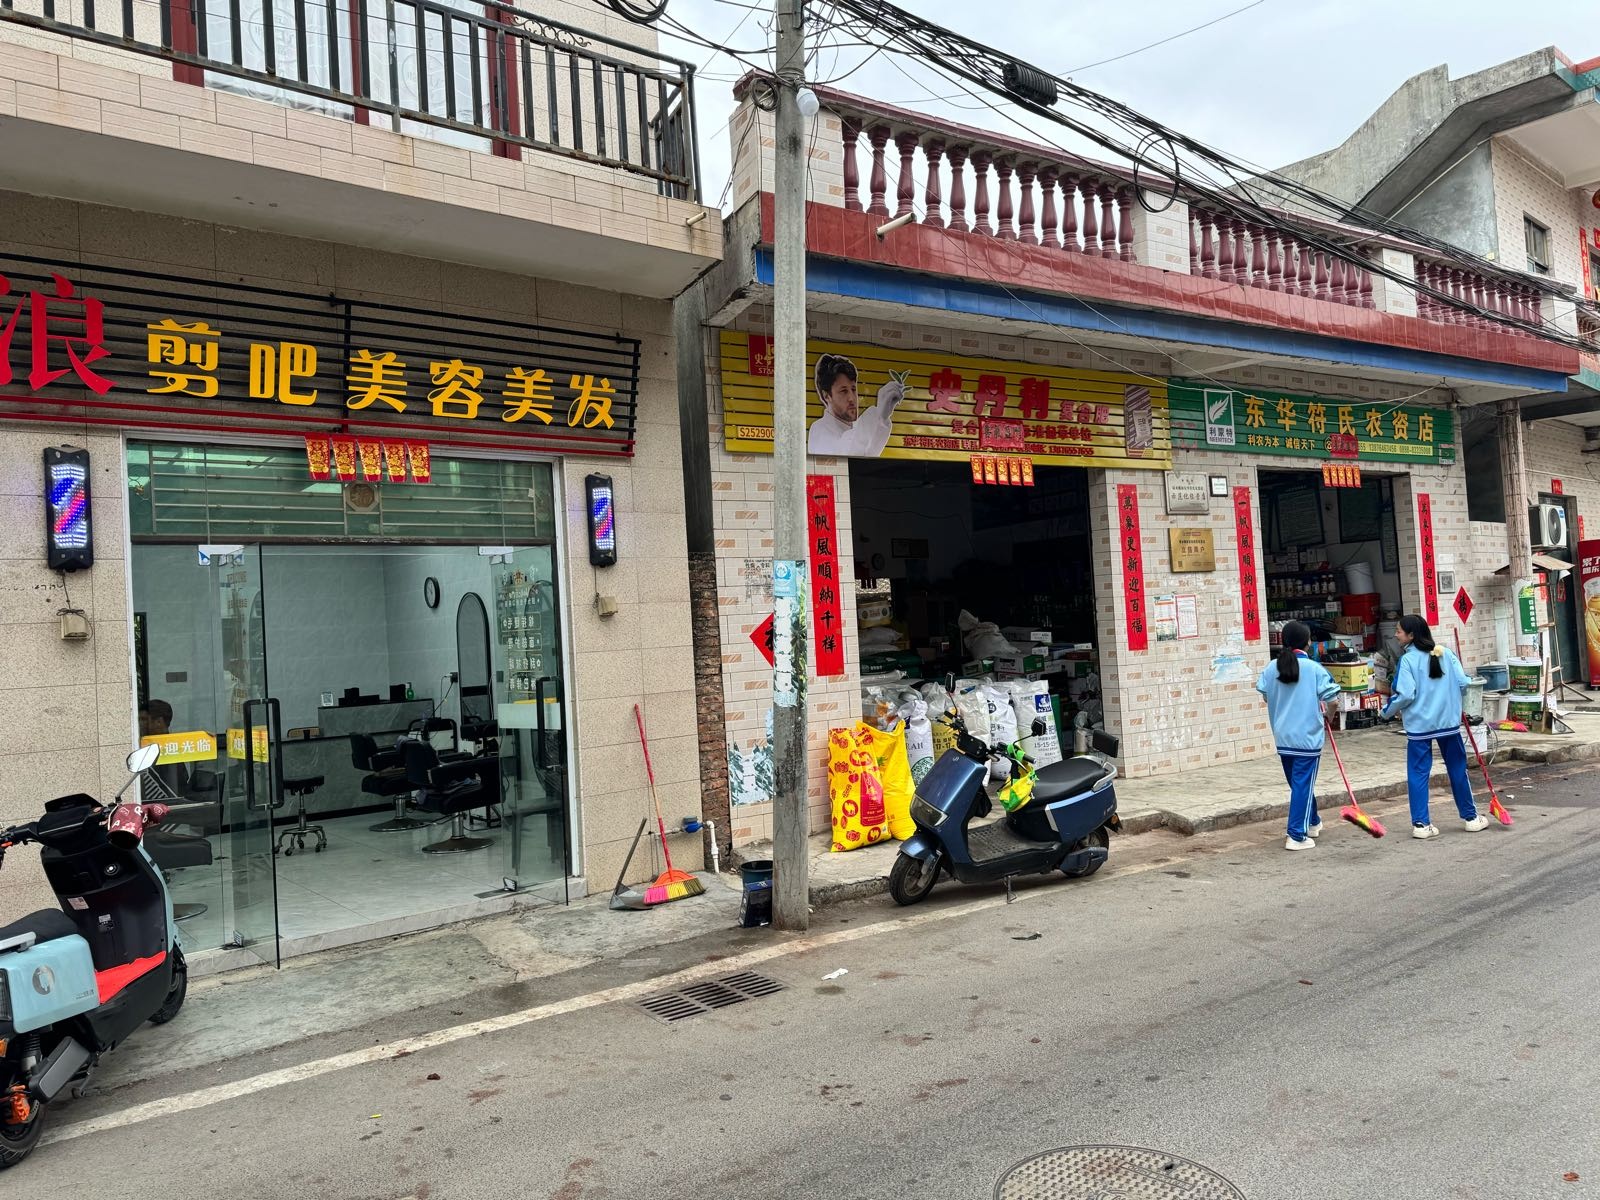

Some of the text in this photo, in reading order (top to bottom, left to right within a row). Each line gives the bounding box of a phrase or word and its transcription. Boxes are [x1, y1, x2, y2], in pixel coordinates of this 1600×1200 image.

[0, 273, 617, 430] 浪 剪吧美容美发
[926, 368, 1050, 420] 史丹利
[1059, 400, 1111, 424] 复合肥
[1244, 396, 1434, 442] 东华符氏农资店
[1247, 434, 1316, 451] 利农为本 诚信天下
[813, 495, 837, 655] 一帆風順納千祥
[159, 738, 211, 756] 迎光临
